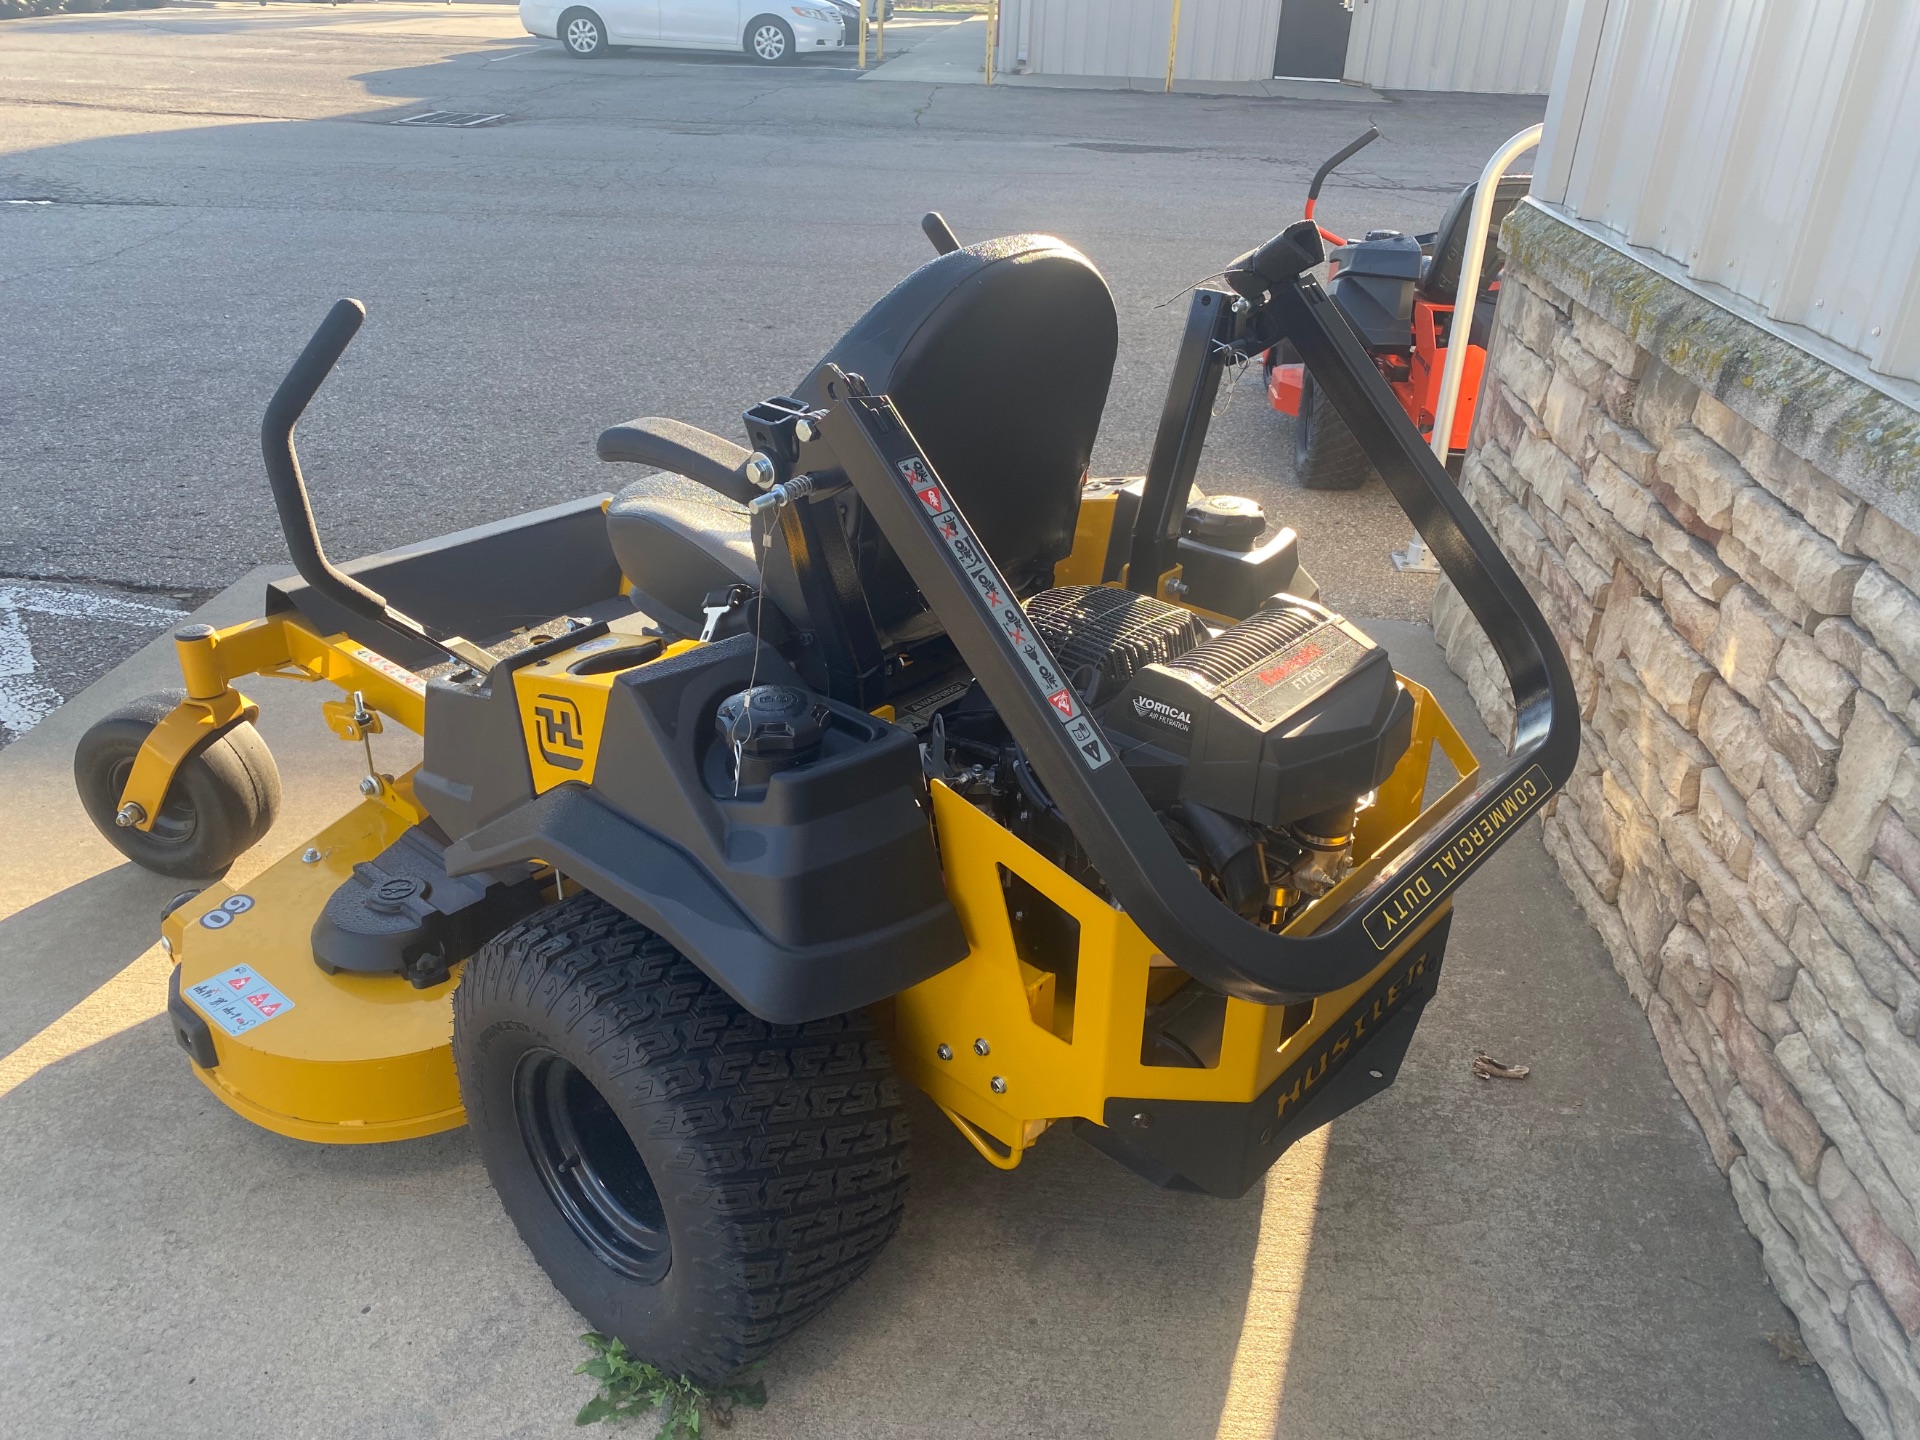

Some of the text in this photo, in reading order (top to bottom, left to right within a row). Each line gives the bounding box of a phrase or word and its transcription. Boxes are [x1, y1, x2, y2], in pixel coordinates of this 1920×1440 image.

[1291, 665, 1326, 690] FT730V
[1138, 695, 1192, 724] VORTICAL
[1148, 711, 1190, 732] AIR FILTRATION
[1382, 778, 1538, 931] COMMERCIAL DUTY
[1277, 952, 1430, 1118] HUSTLER
